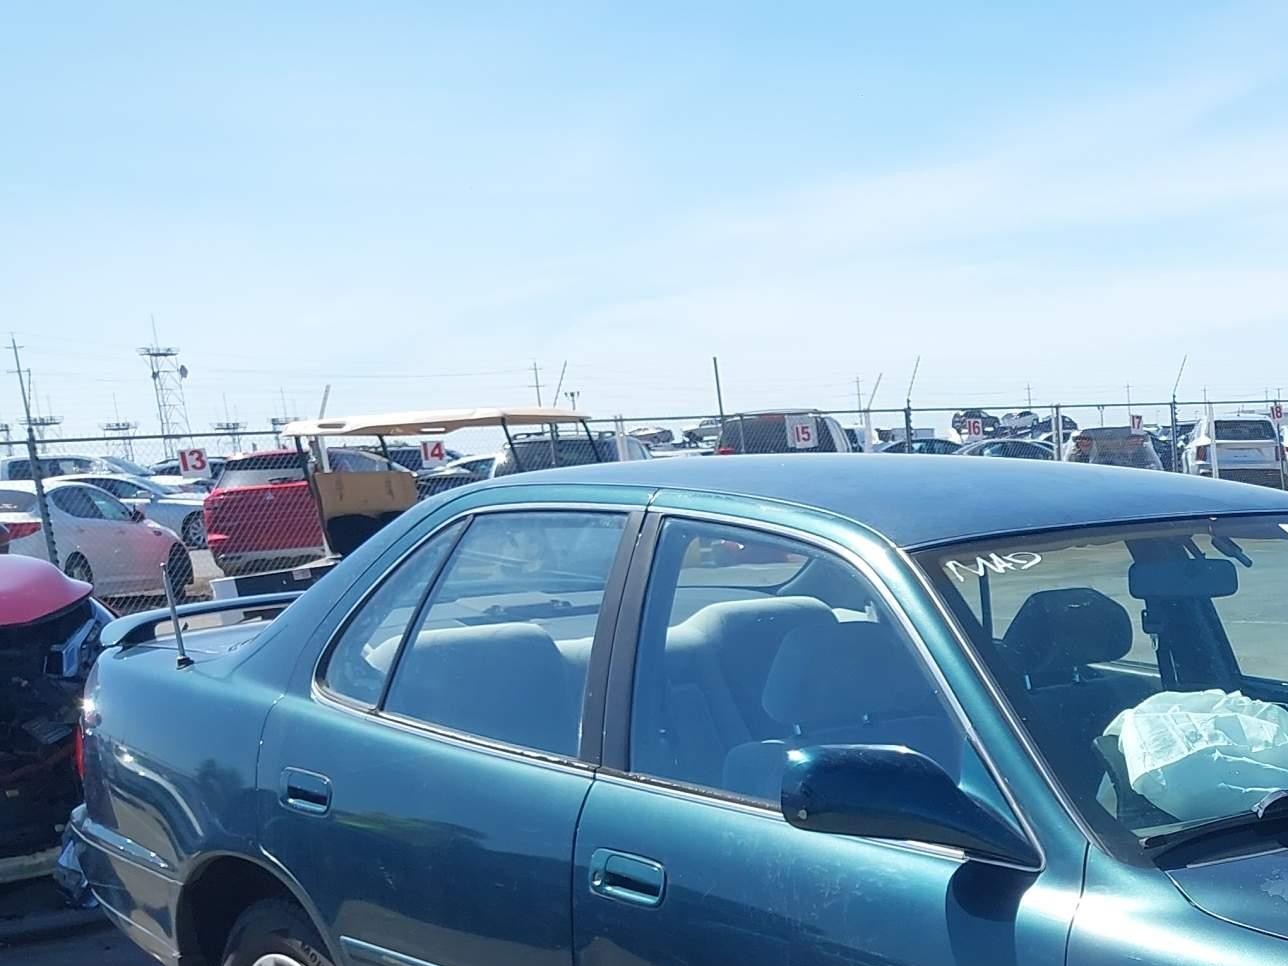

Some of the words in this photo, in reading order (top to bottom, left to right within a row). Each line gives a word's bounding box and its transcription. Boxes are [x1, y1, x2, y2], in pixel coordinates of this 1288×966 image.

[1271, 405, 1283, 420] 18
[968, 420, 981, 436] 16
[1132, 415, 1143, 430] 17
[795, 425, 811, 442] 15
[423, 442, 446, 461] 14
[179, 449, 208, 472] 13
